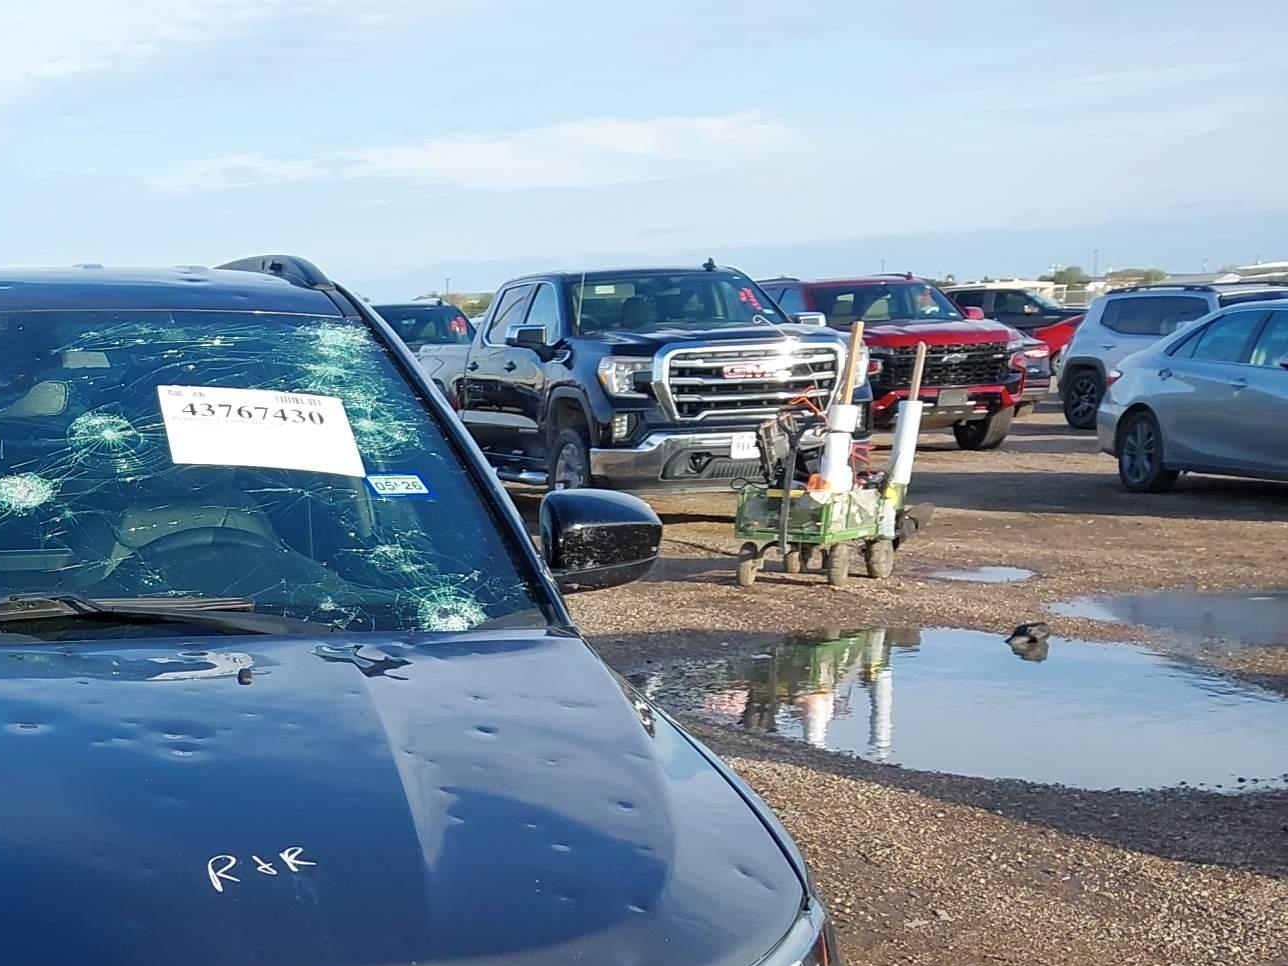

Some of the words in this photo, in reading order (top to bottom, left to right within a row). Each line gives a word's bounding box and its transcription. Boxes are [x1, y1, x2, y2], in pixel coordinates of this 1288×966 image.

[181, 401, 325, 426] 43767430
[207, 854, 241, 893] R
[278, 845, 318, 873] R
